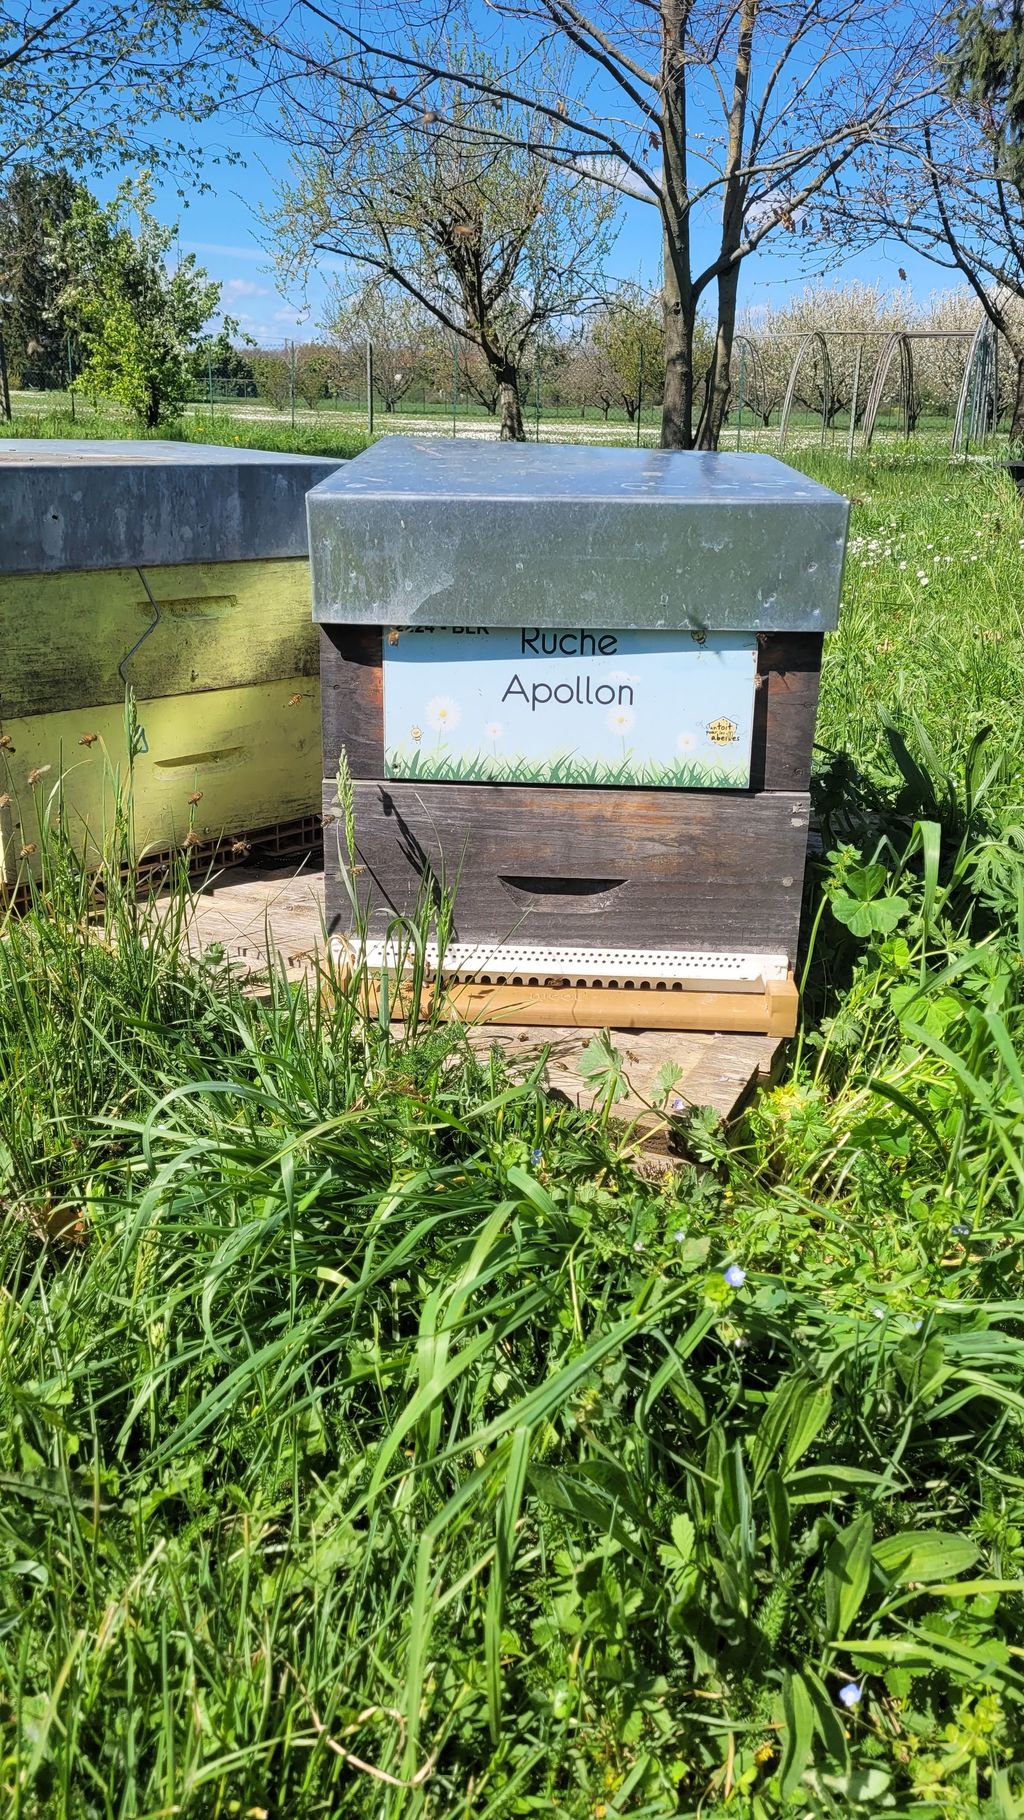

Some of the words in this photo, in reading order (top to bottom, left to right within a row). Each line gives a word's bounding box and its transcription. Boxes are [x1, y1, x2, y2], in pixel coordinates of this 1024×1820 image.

[521, 628, 618, 656] Ruche
[501, 674, 634, 711] Apollon
[717, 722, 732, 730] toit
